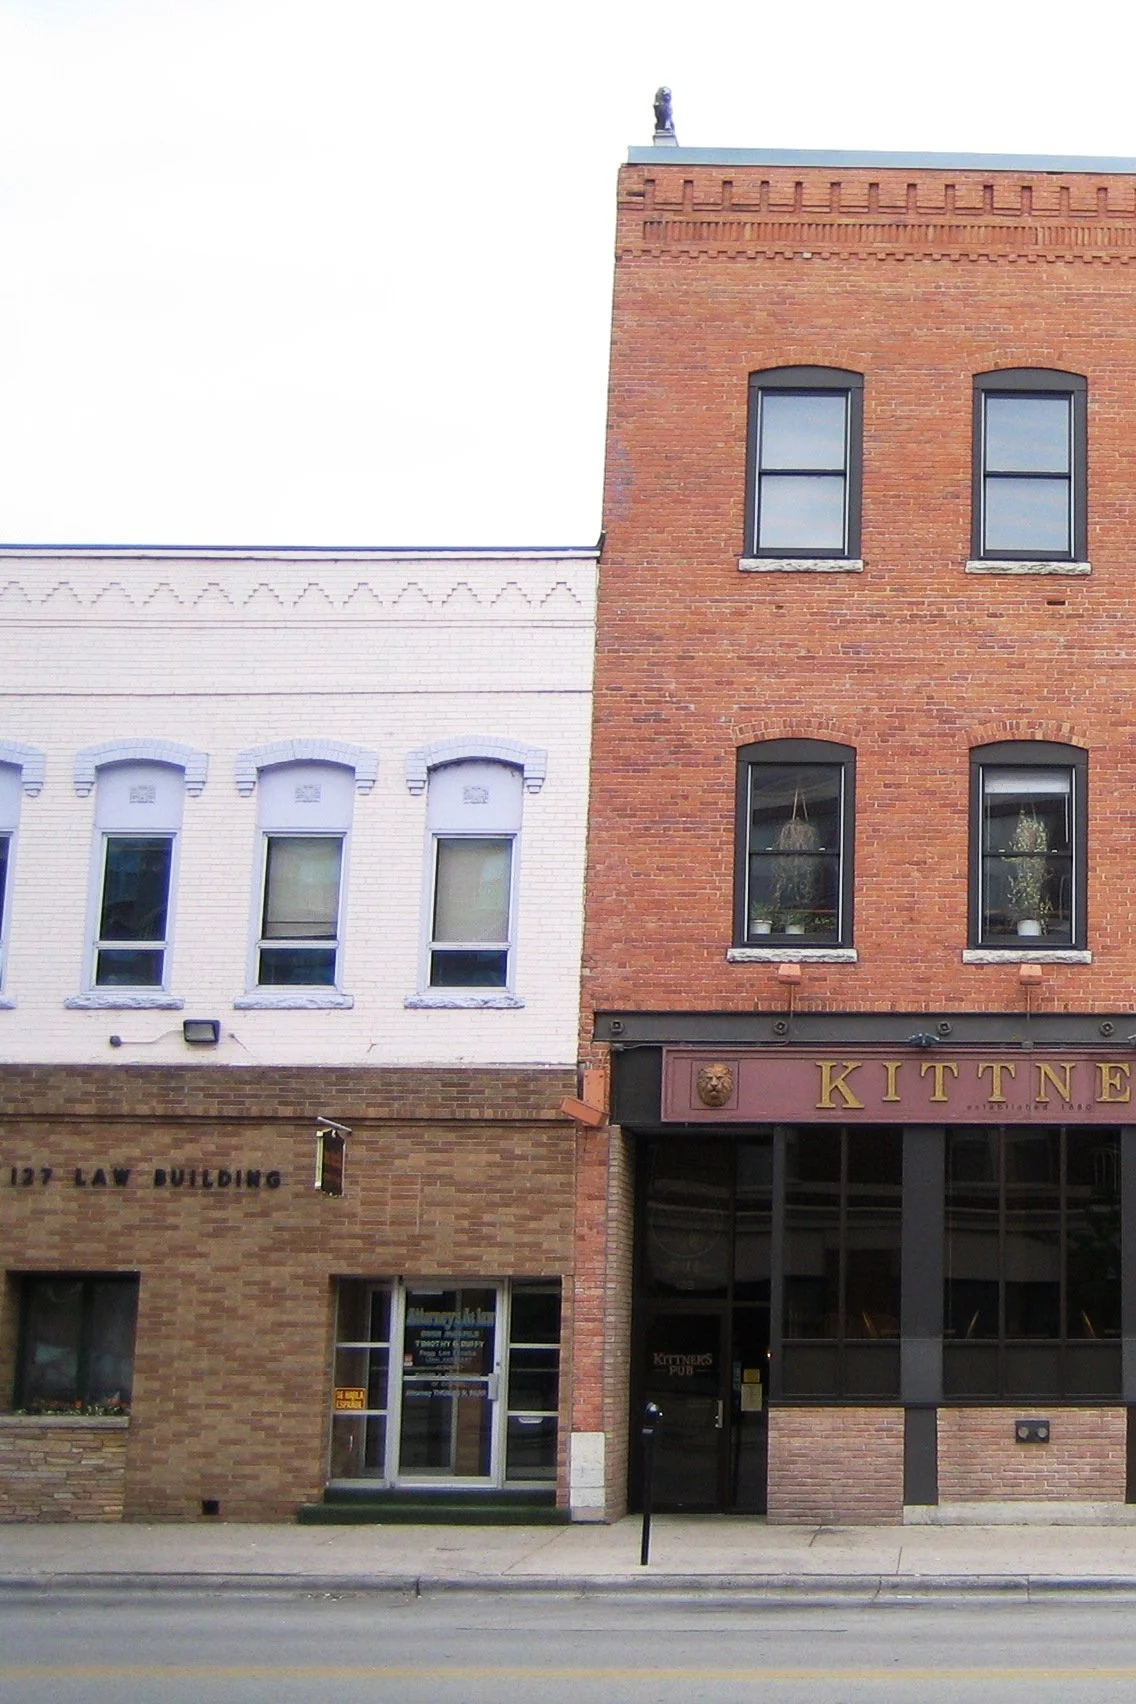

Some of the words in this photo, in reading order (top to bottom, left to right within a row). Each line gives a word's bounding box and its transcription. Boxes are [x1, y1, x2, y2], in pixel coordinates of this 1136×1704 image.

[966, 1103, 1049, 1112] established
[11, 1167, 52, 1187] 127
[74, 1167, 131, 1188] LAW
[154, 1168, 282, 1189] BUILDING
[415, 1340, 451, 1348] TIMOTHY
[668, 1365, 695, 1377] PUB
[345, 1391, 364, 1399] HABLA
